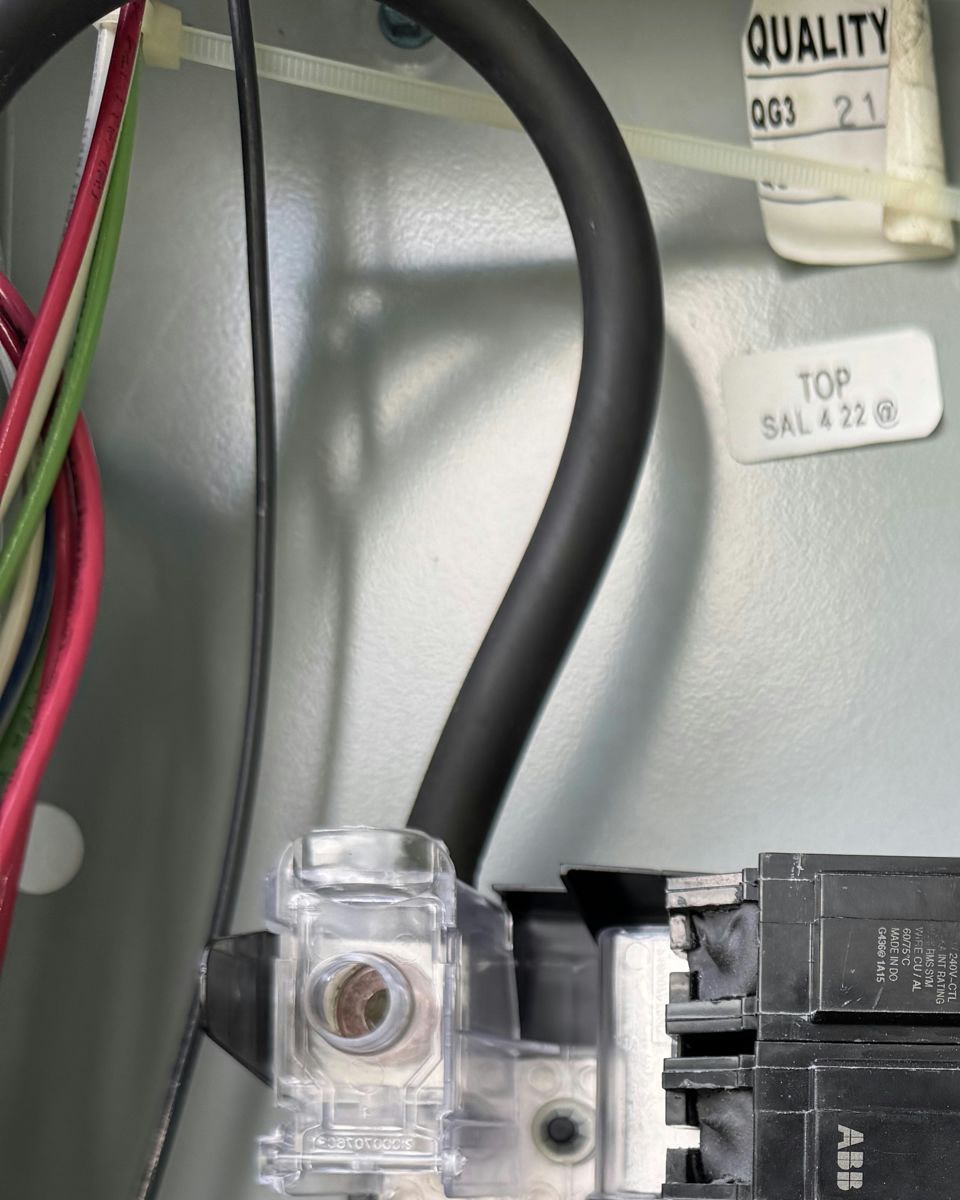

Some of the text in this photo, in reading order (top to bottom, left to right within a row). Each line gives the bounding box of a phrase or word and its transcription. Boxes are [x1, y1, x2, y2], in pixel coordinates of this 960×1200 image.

[746, 9, 888, 64] QUALITY
[750, 92, 877, 129] QG3 21
[799, 367, 851, 402] TOP
[761, 406, 811, 440] SAL
[819, 403, 833, 431] 4
[840, 401, 868, 429] 22
[889, 927, 900, 982] MADE IN DO
[913, 956, 923, 972] CU
[912, 979, 922, 992] AL
[924, 968, 934, 988] SYM
[935, 954, 946, 1005] INT RATING
[837, 1124, 864, 1191] ABB
